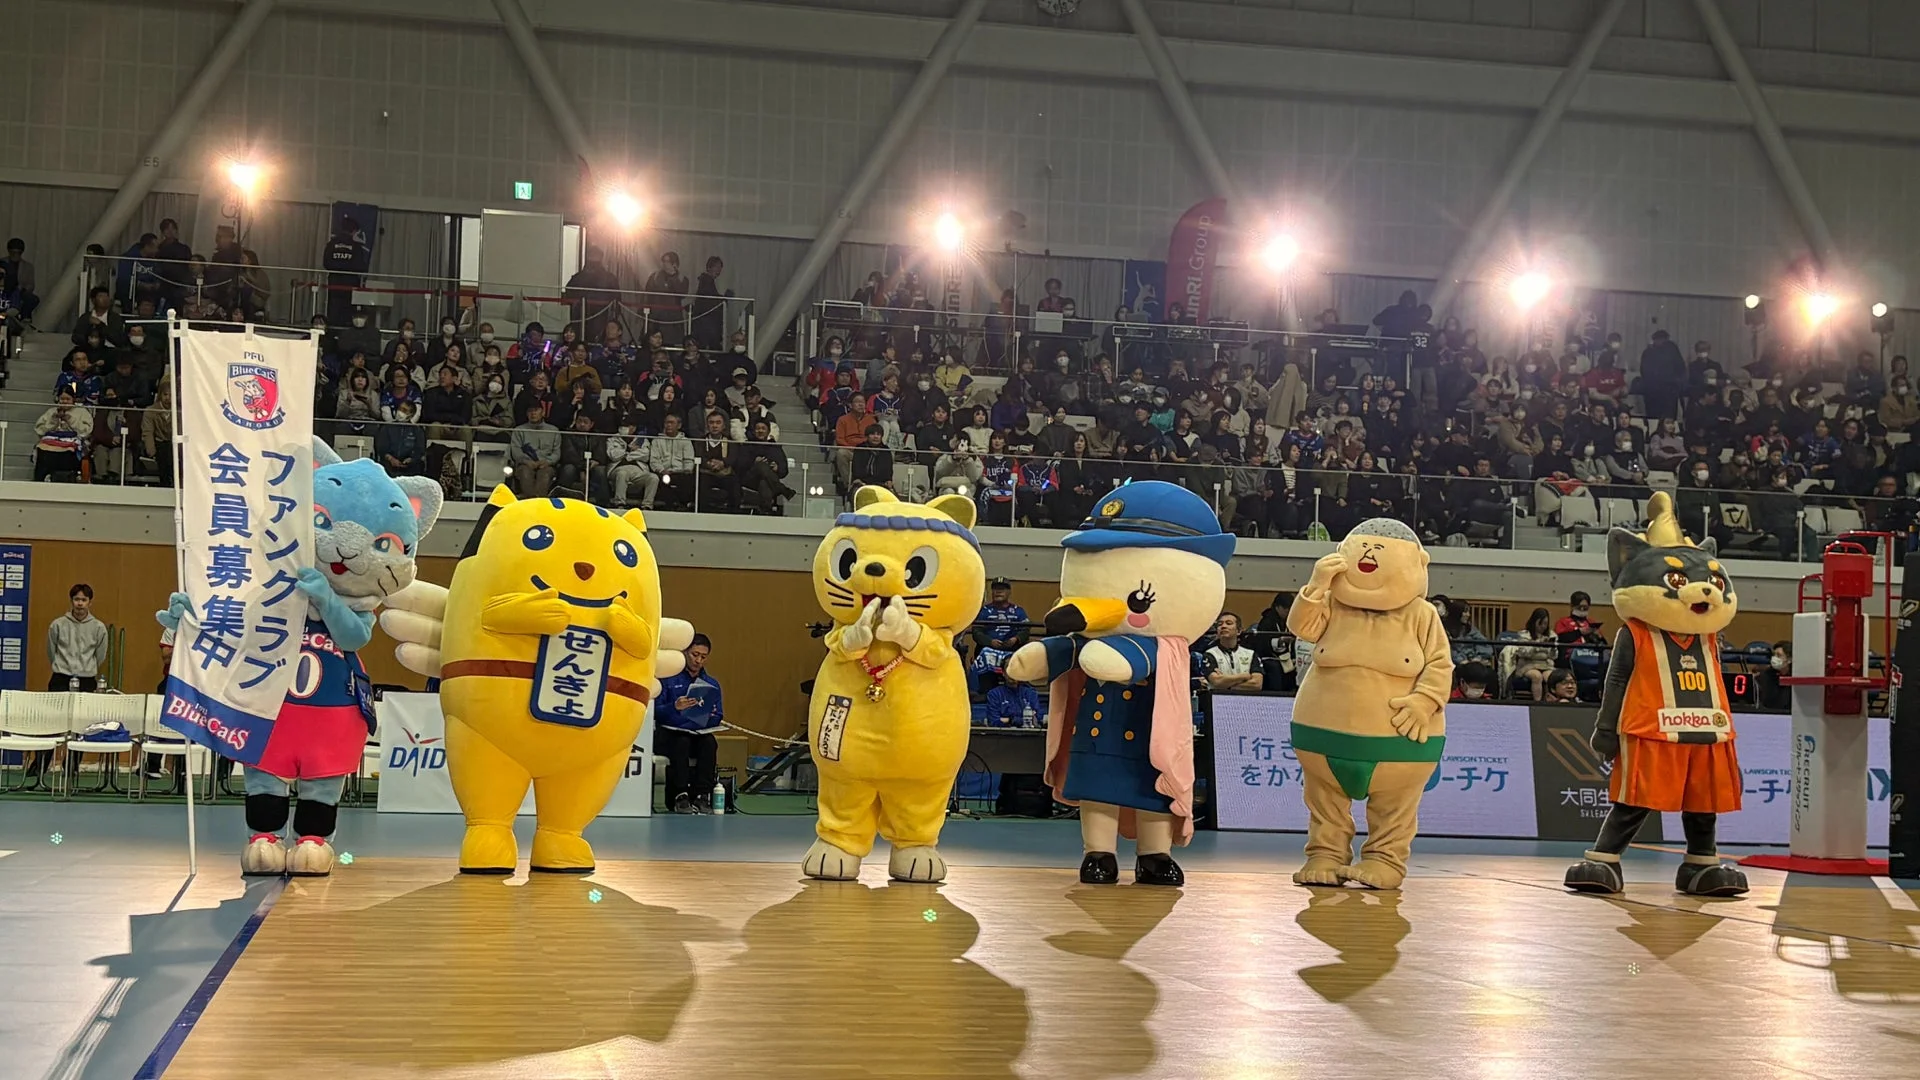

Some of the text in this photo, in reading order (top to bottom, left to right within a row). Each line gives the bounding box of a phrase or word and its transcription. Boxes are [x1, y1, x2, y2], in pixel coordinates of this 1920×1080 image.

[243, 351, 265, 363] PFU
[231, 365, 277, 382] BlueCats
[226, 412, 282, 429] KAHOKU
[191, 442, 253, 671] 会員募集中
[239, 450, 301, 690] ファンクラブ
[1676, 671, 1706, 692] 100
[1734, 675, 1746, 695] 0
[166, 692, 250, 751] BlueCats
[1478, 757, 1509, 765] TICKET
[1743, 768, 1778, 776] LAWSON
[1802, 747, 1811, 812] RECRUIT
